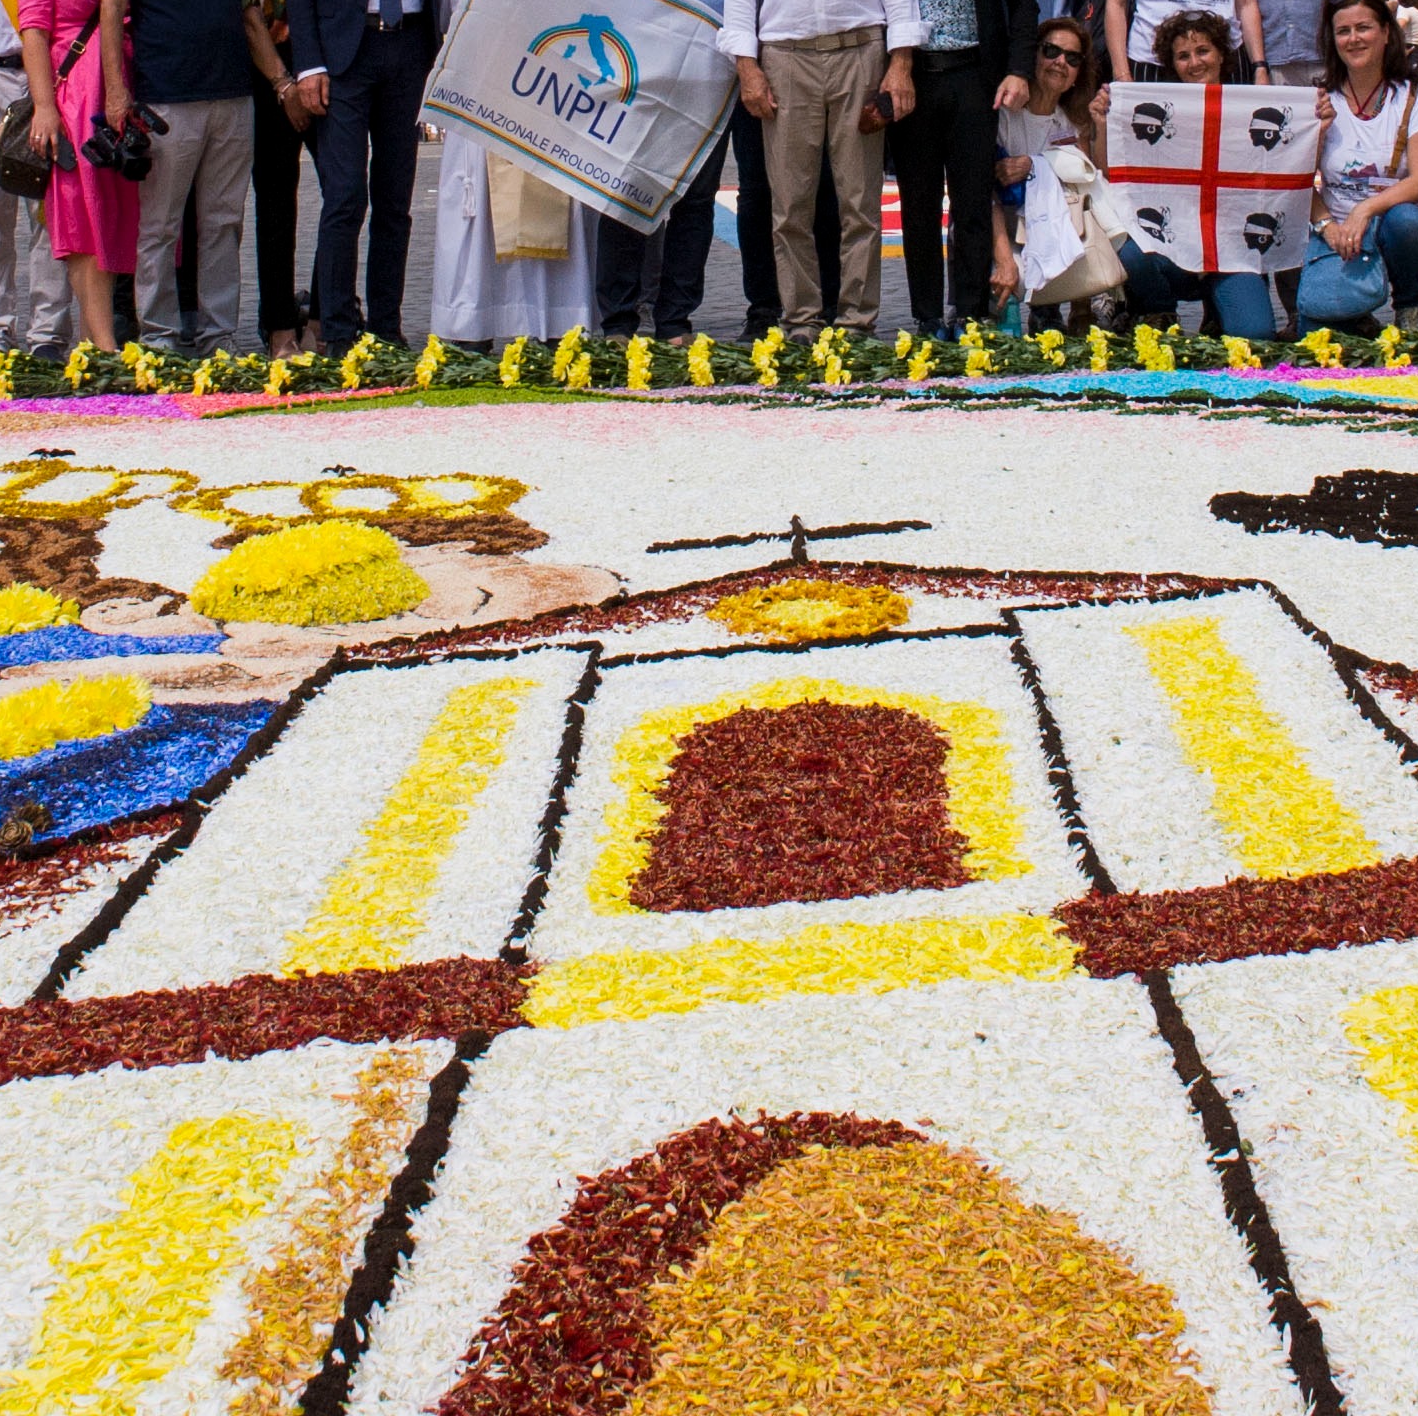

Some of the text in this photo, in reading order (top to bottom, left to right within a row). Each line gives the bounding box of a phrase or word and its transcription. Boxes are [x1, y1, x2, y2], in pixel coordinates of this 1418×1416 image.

[431, 86, 654, 208] UNIONE NAZIONALE PROLOCO D'ITALIA
[511, 56, 627, 145] UNPLI
